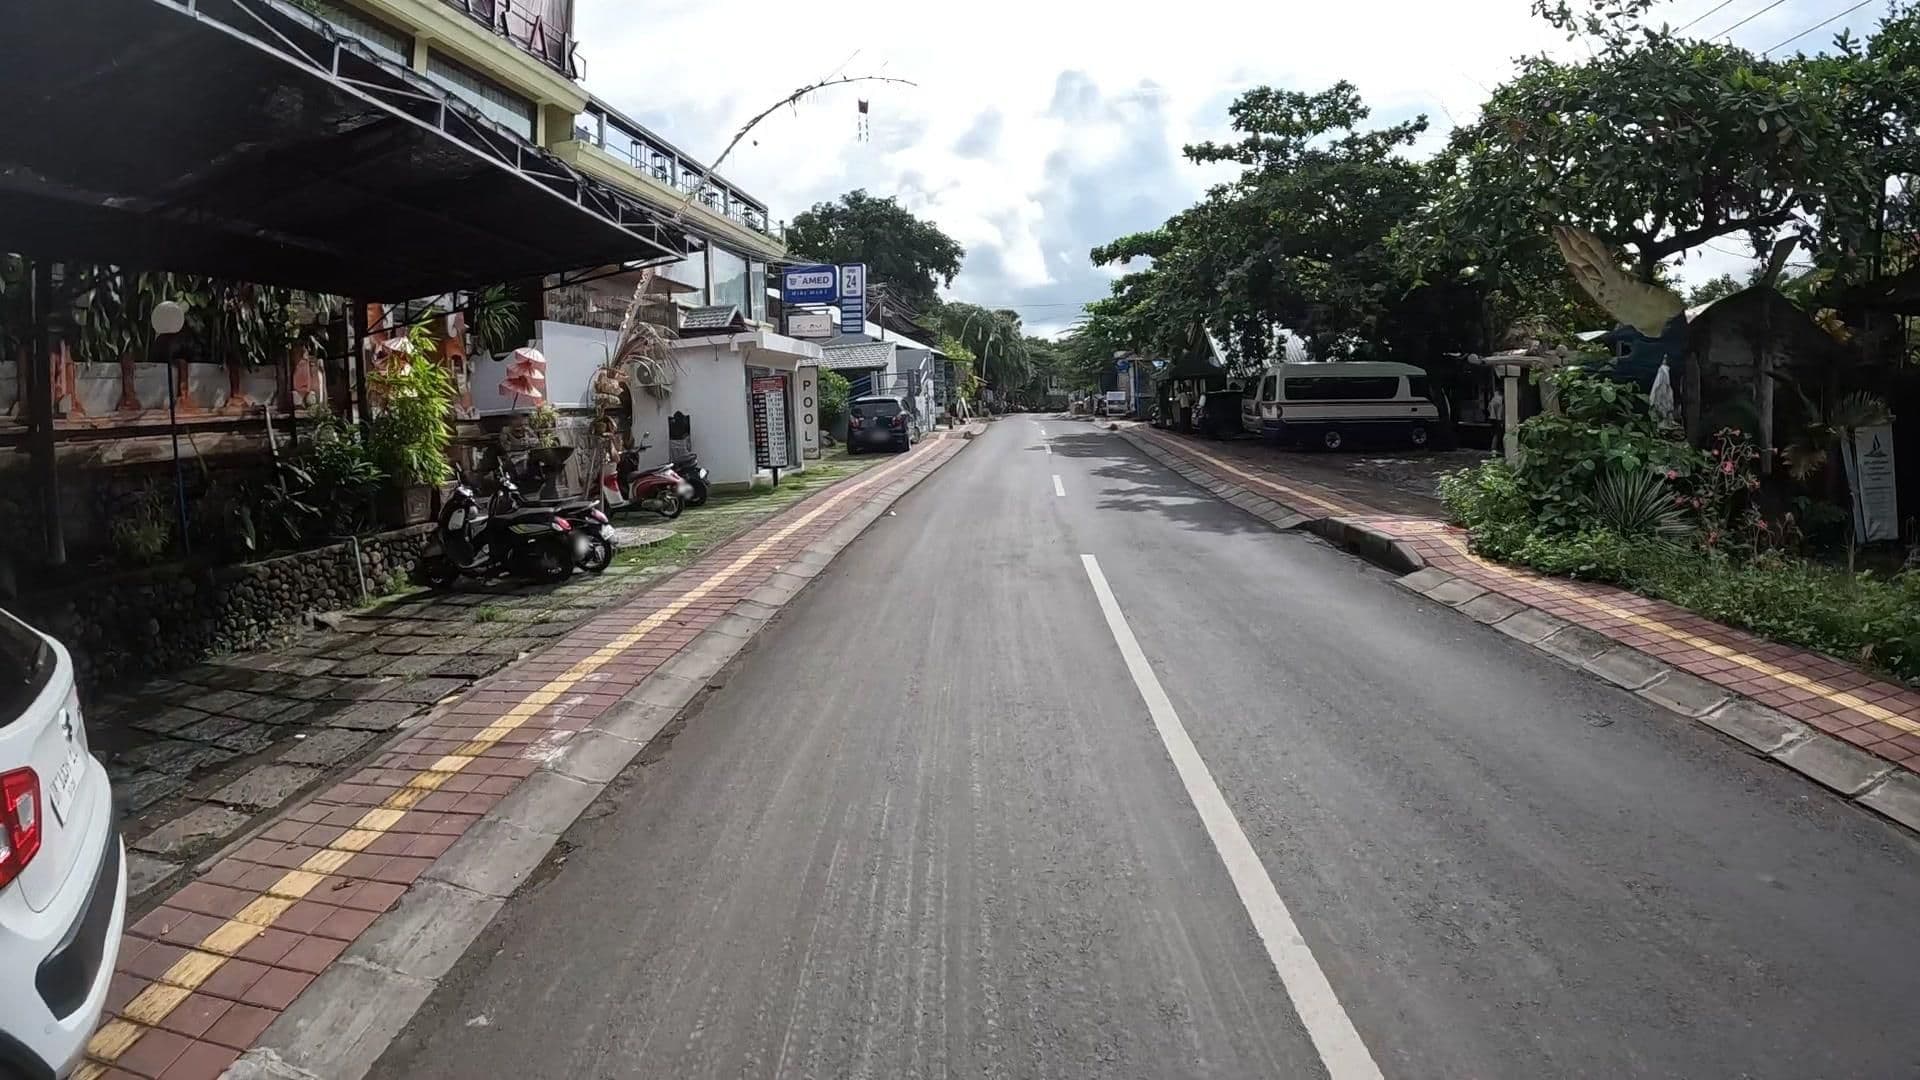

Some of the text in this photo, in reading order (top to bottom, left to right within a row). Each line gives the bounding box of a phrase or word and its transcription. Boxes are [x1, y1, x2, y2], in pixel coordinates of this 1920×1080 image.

[802, 276, 830, 285] AMED
[846, 275, 857, 289] 24
[803, 380, 813, 442] POOL
